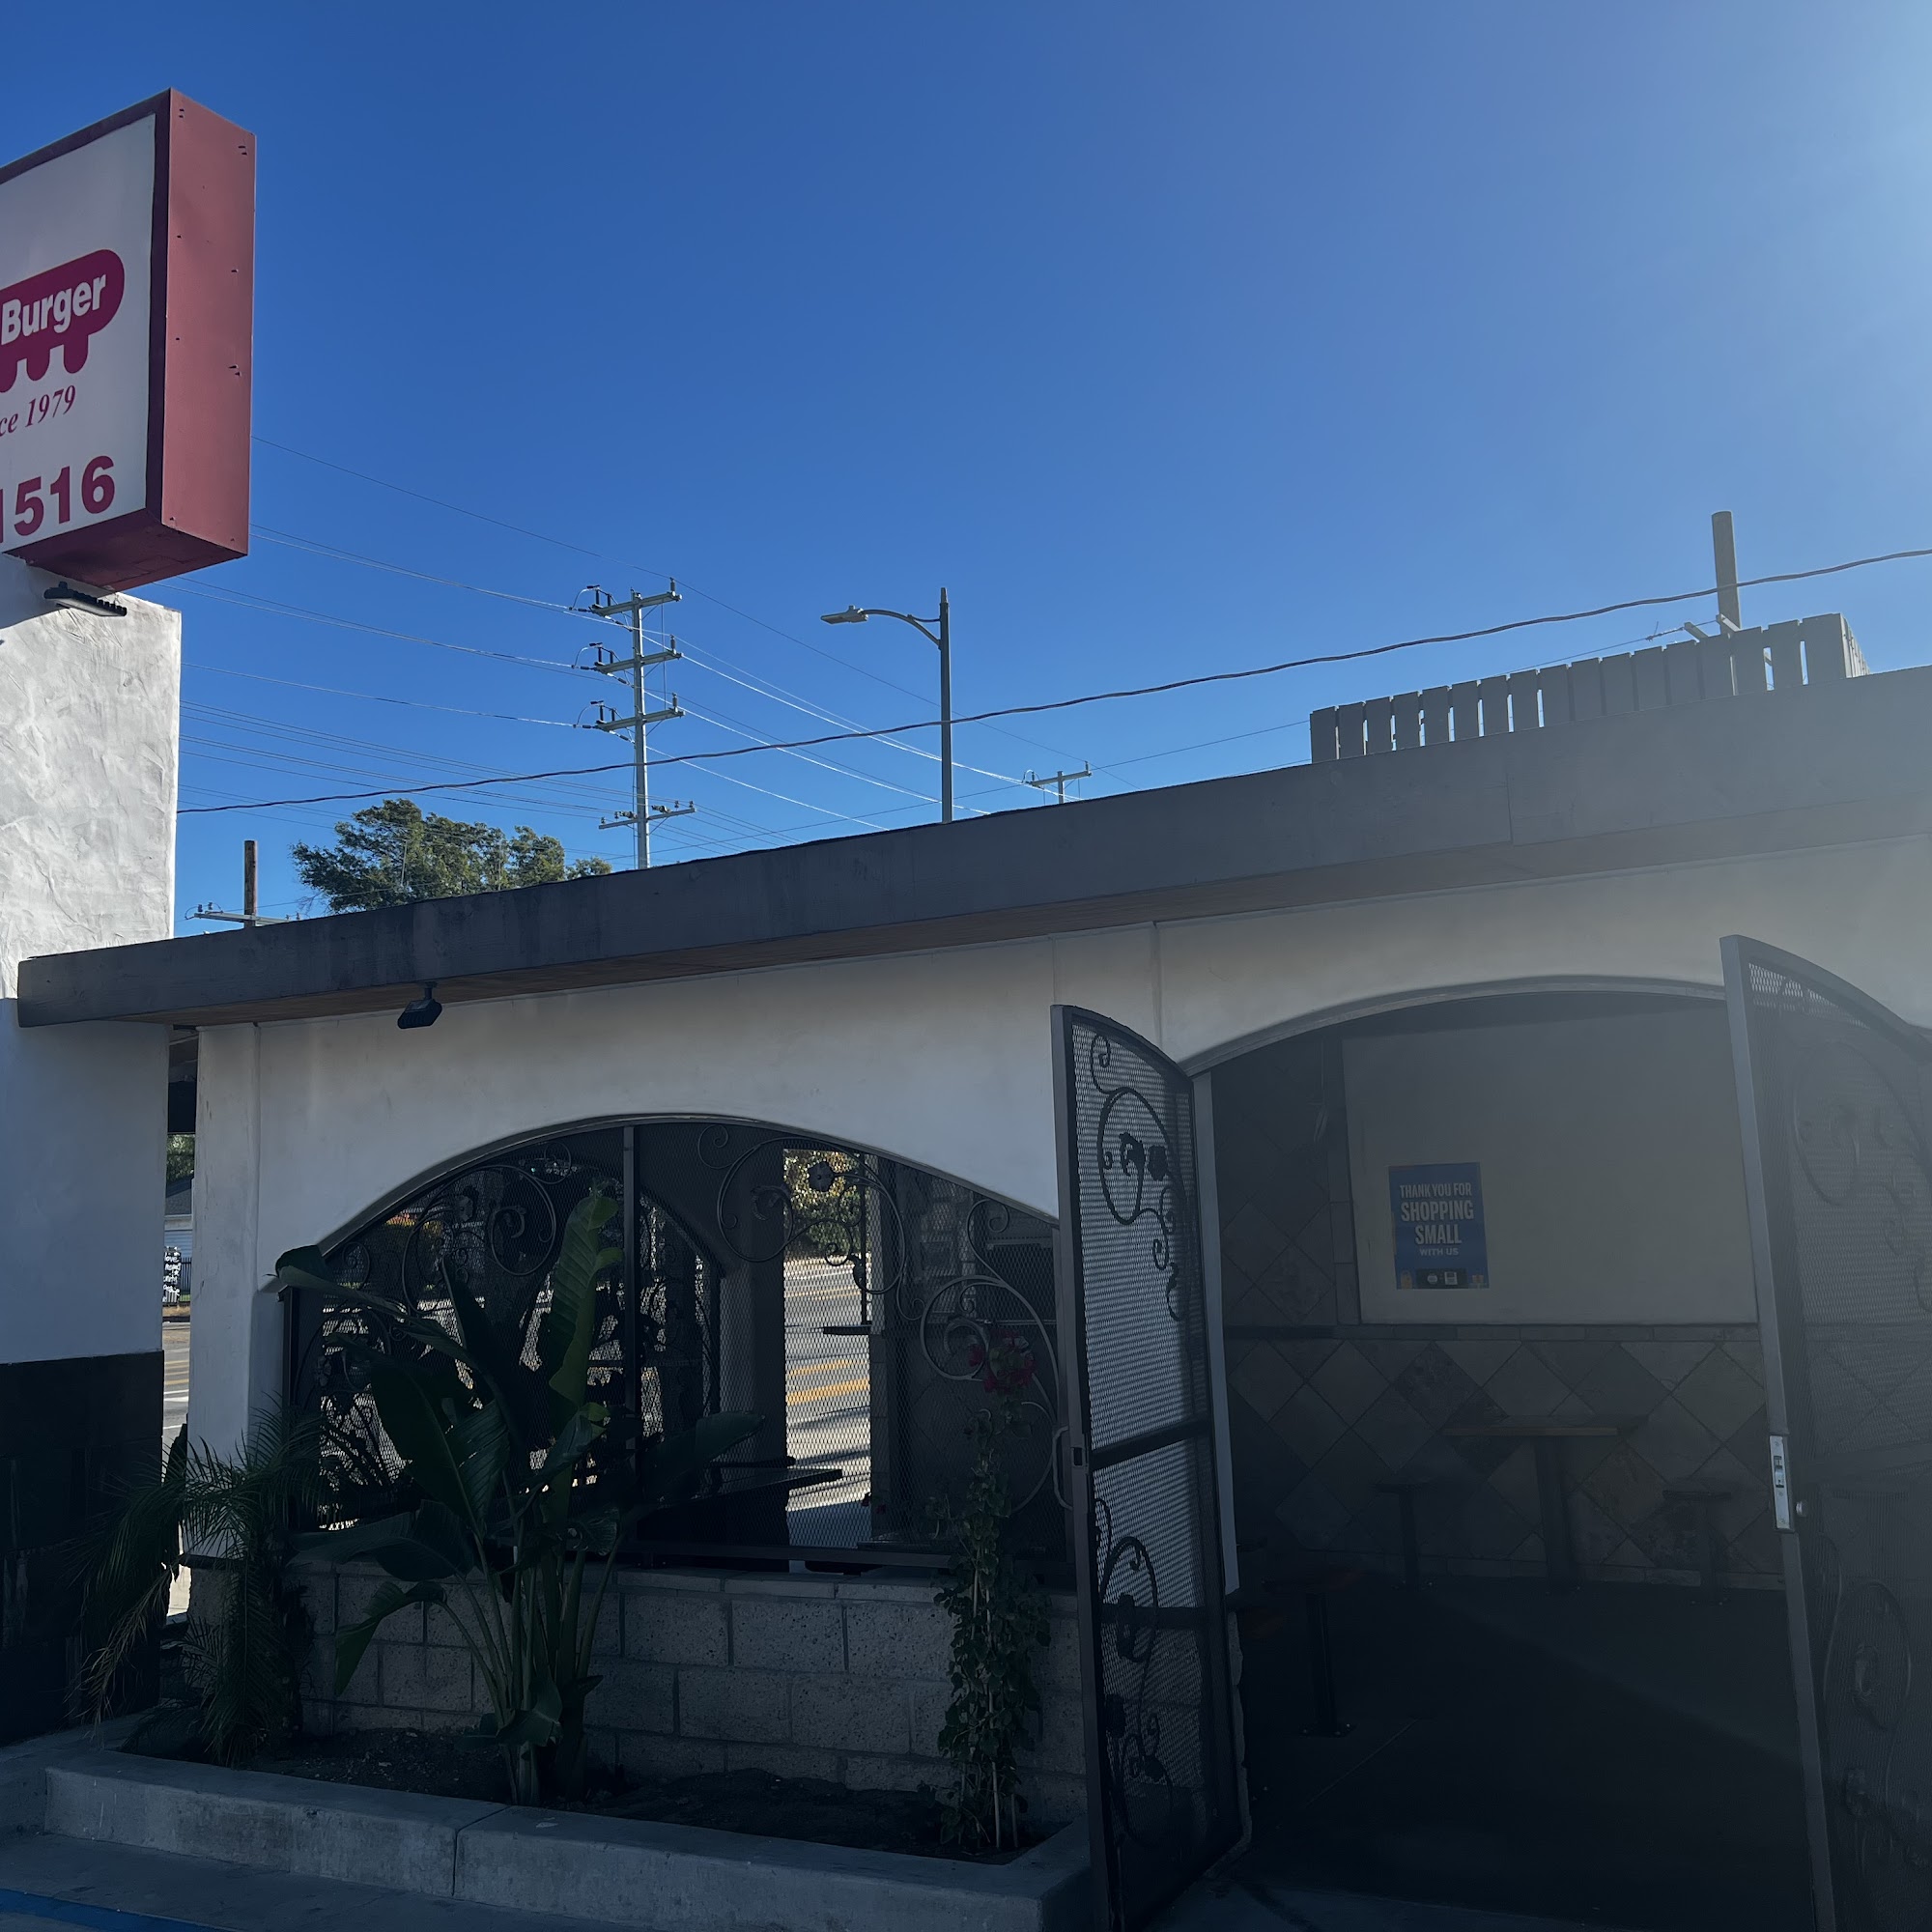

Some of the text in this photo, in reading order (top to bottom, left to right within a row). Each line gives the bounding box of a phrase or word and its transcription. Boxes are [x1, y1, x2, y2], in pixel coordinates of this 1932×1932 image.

[1, 274, 106, 346] Burger
[25, 385, 76, 428] 1979
[0, 455, 115, 544] 516
[1400, 1182, 1473, 1199] THANK YOU FOR
[1401, 1200, 1474, 1222] SHOPPING
[1415, 1224, 1463, 1245] SMALL
[1419, 1248, 1444, 1257] WITH
